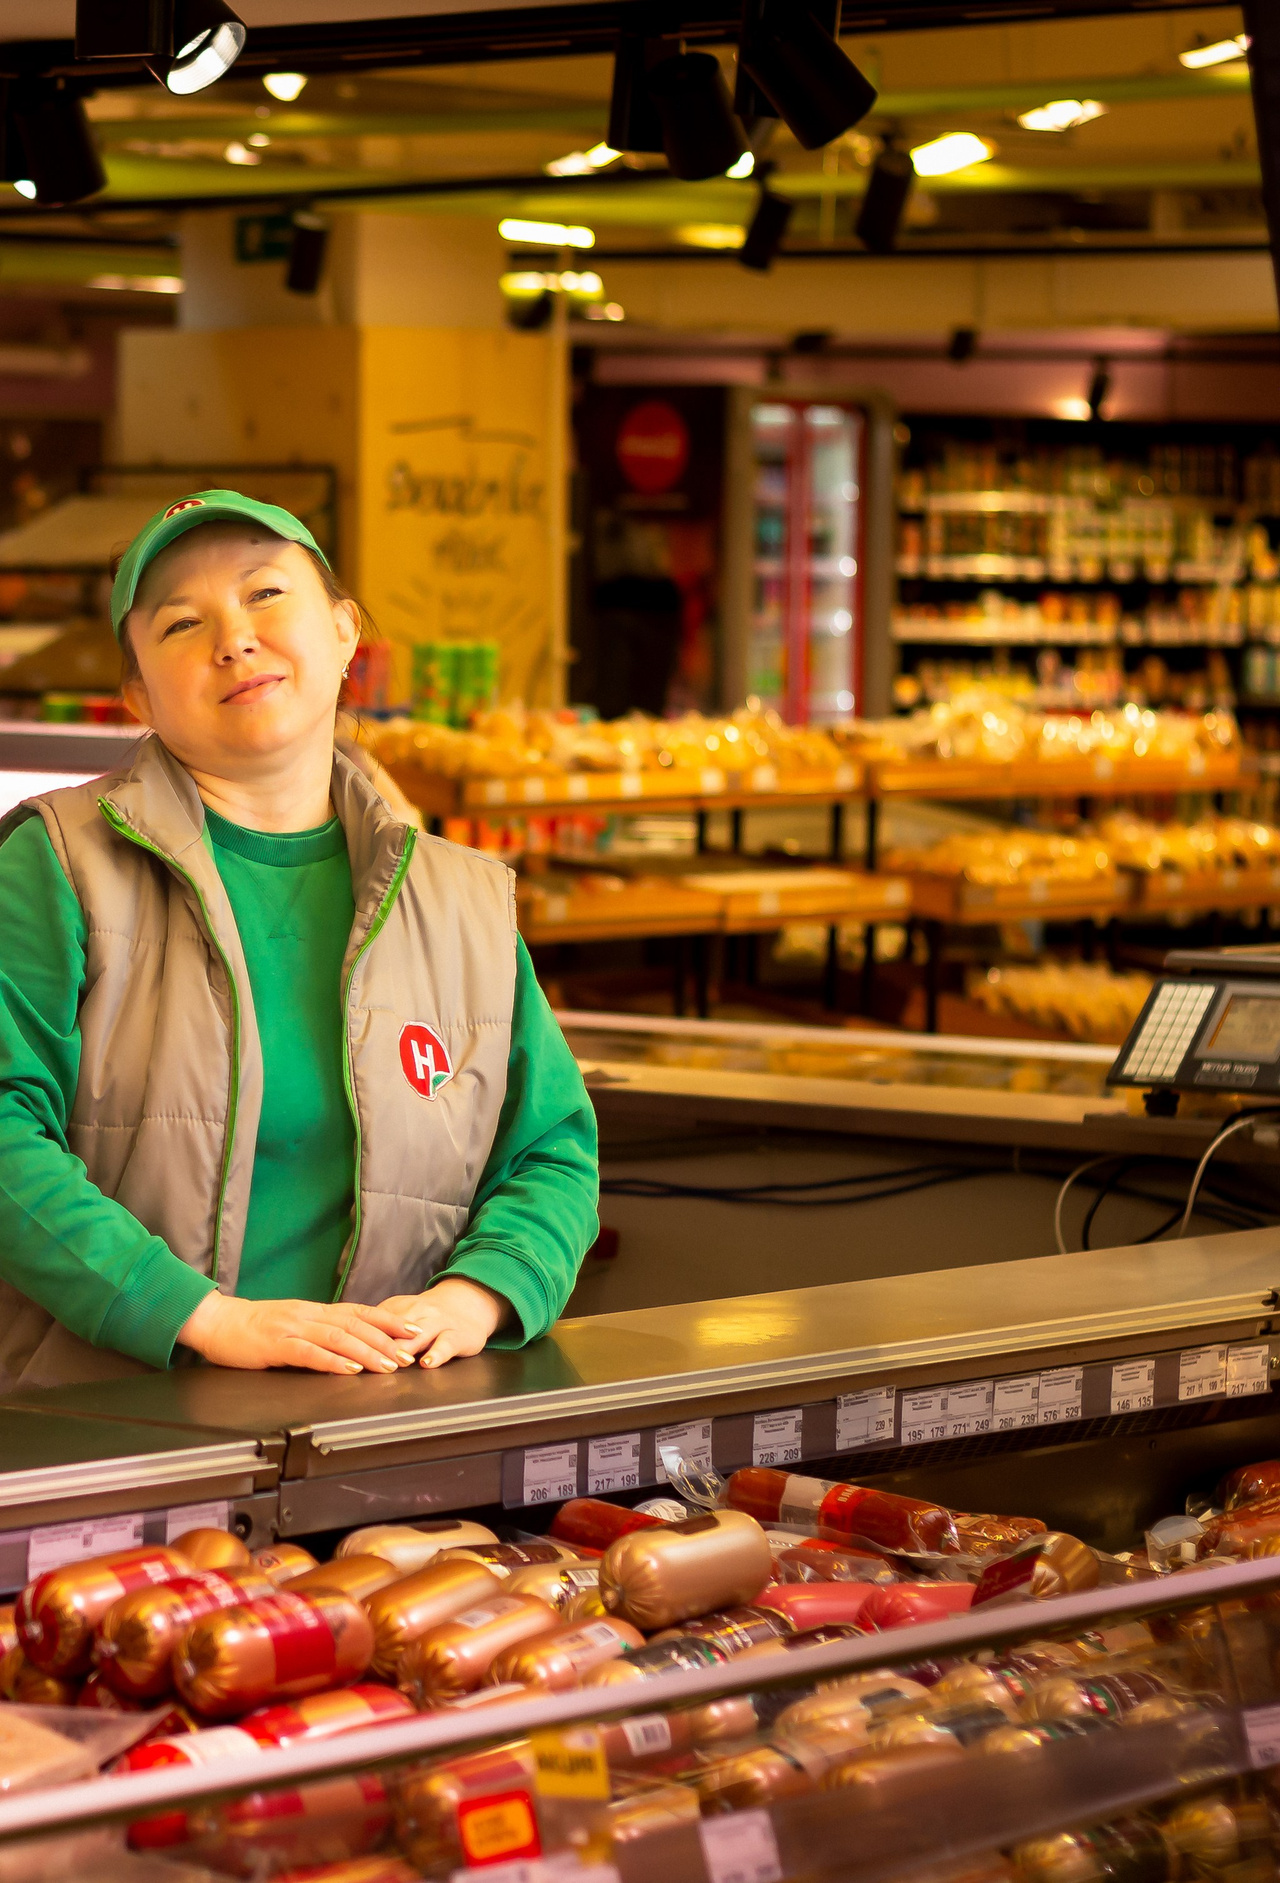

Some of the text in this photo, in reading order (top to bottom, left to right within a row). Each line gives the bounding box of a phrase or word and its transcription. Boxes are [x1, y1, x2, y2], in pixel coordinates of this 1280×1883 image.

[1231, 1383, 1245, 1395] 217
[1117, 1399, 1130, 1411] 146
[1138, 1395, 1152, 1407] 135
[1043, 1409, 1057, 1422] 576
[1065, 1406, 1079, 1418] 529
[975, 1419, 989, 1431] 249
[999, 1417, 1013, 1429] 260
[1021, 1413, 1035, 1426] 239
[907, 1429, 922, 1442] 195
[930, 1425, 945, 1438] 179
[952, 1423, 967, 1435] 271
[759, 1452, 775, 1464] 228
[783, 1447, 799, 1461] 209
[595, 1478, 611, 1491] 217
[621, 1473, 636, 1487] 199
[530, 1487, 548, 1502] 206
[557, 1483, 573, 1497] 189
